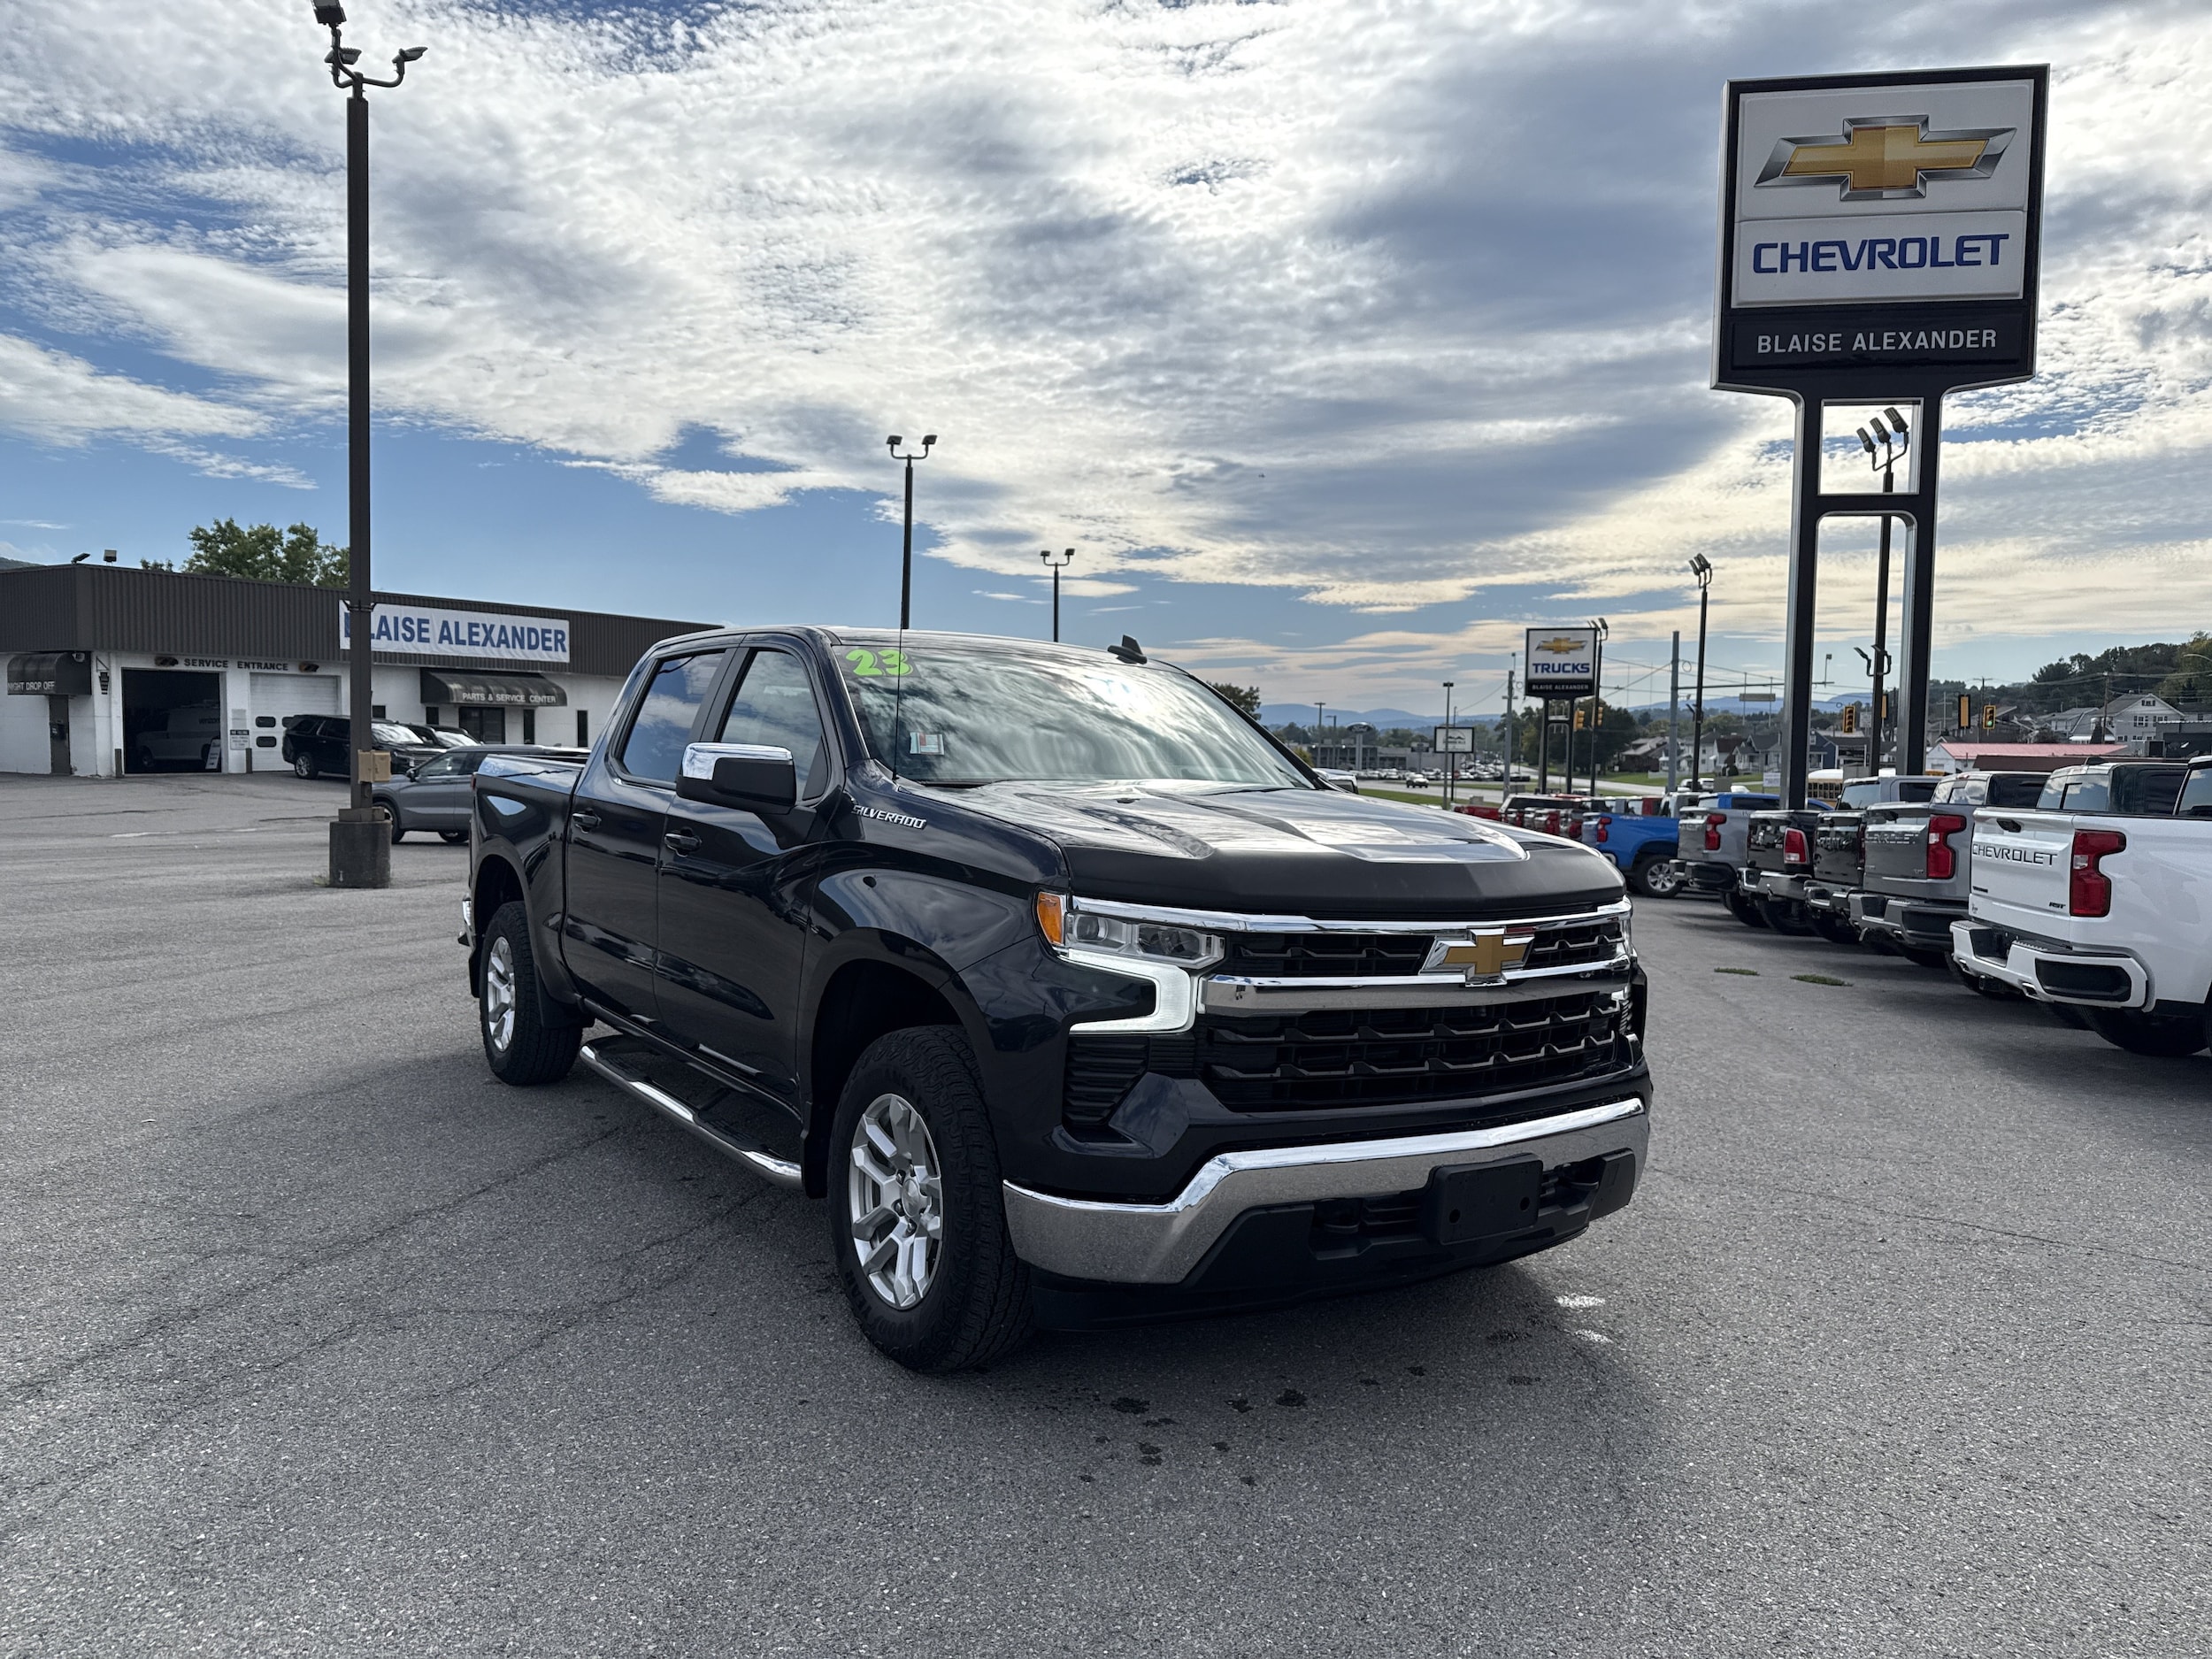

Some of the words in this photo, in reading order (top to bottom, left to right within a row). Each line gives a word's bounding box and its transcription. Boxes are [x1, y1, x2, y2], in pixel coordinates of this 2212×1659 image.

[1753, 234, 2009, 273] CHEVROLET
[1757, 333, 1842, 353] BLAISE
[1852, 329, 1997, 351] ALEXANDER
[438, 620, 567, 653] ALEXANDER
[183, 658, 229, 668] SERVICE
[237, 660, 288, 671] ENTRANCE
[846, 649, 913, 676] 23
[1532, 663, 1590, 673] TRUCKS
[7, 681, 24, 691] NIGHT
[26, 681, 42, 691] DROP
[43, 680, 55, 690] OFF
[463, 692, 486, 702] PARTS
[488, 693, 494, 702] &
[495, 694, 526, 703] SERVICE
[529, 695, 557, 703] CENTER
[851, 804, 927, 829] SILVERADO
[1972, 843, 2058, 866] CHEVROLET
